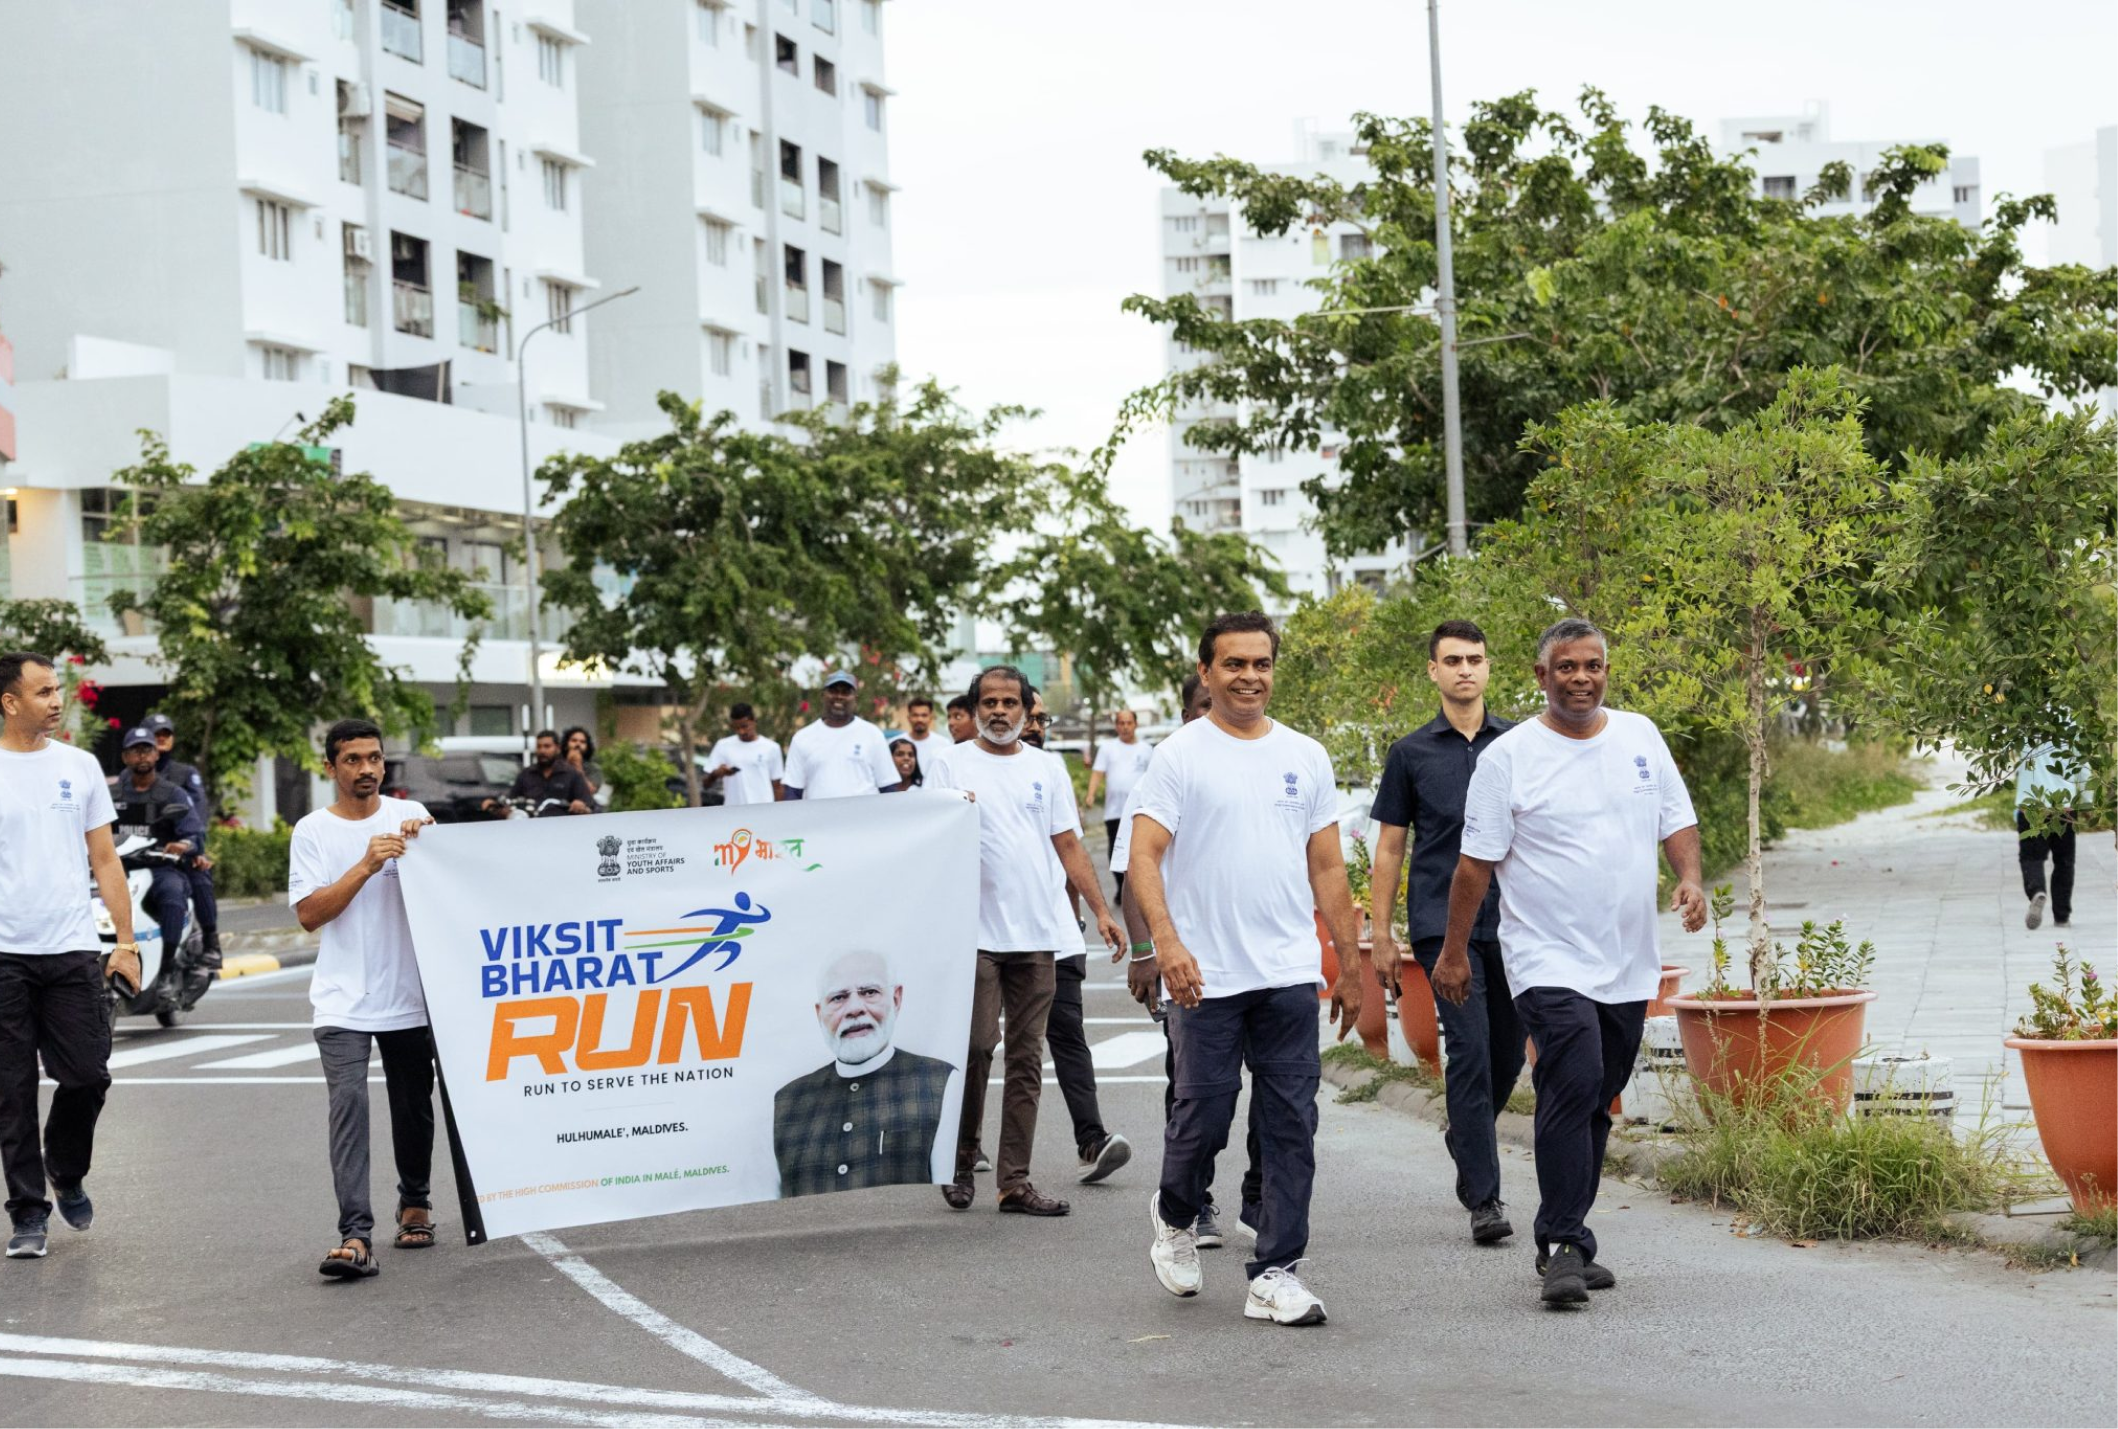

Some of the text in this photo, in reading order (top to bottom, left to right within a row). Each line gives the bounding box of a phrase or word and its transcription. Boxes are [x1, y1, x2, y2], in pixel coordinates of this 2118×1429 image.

[646, 866, 674, 874] SPORTS
[655, 858, 685, 866] AFFAIRS
[480, 919, 623, 961] VIKSIT
[481, 951, 663, 998] BHARAT
[486, 982, 753, 1081] RUN
[524, 1067, 734, 1097] RUN TO SERVE THE NATION
[632, 1122, 688, 1137] MALDIVES.
[486, 1192, 496, 1202] BY
[498, 1189, 514, 1200] THE
[515, 1186, 537, 1197] HIGH
[538, 1179, 599, 1194] COMMISSION
[601, 1177, 614, 1187] OF
[615, 1175, 640, 1185] INDIA
[643, 1173, 652, 1182] IN
[655, 1169, 682, 1182] MALÉ,
[684, 1165, 730, 1178] MALDIVES.
